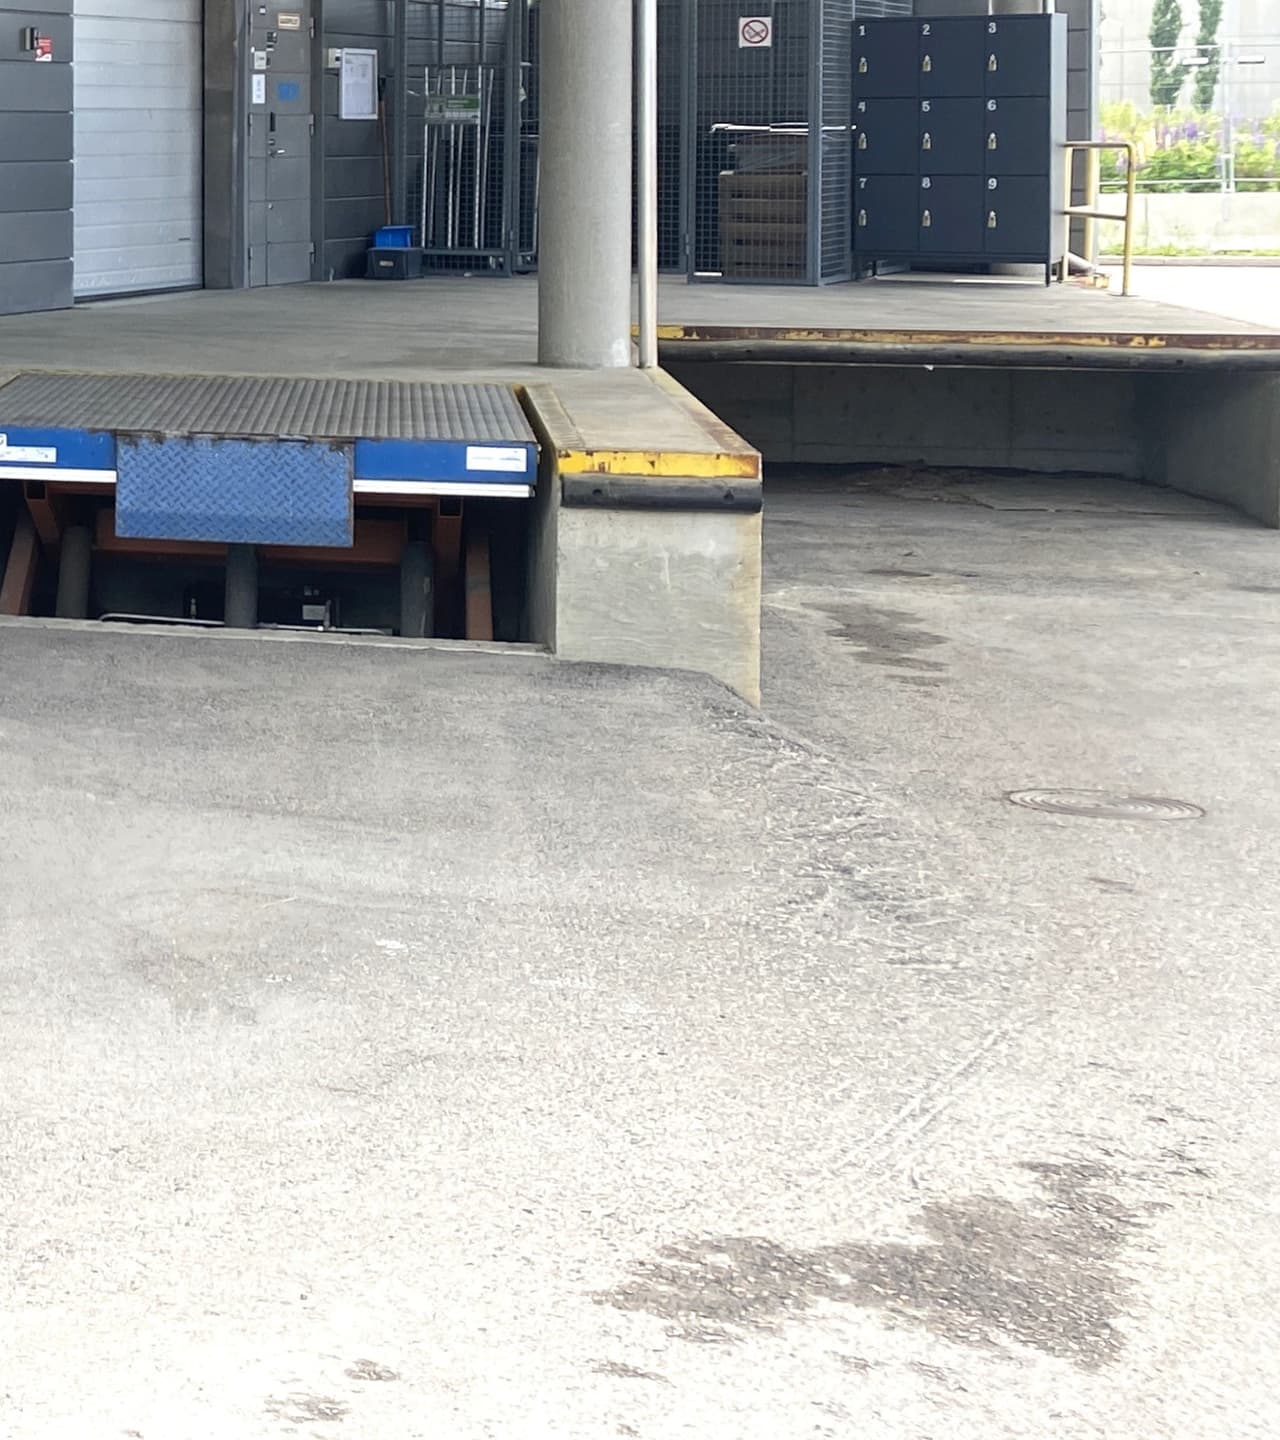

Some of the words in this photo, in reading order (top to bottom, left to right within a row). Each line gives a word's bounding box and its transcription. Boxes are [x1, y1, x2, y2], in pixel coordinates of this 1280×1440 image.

[859, 25, 866, 36] 1
[922, 24, 931, 35] 2
[988, 22, 997, 34] 3
[858, 101, 866, 112] 4
[922, 101, 931, 112] 5
[987, 99, 997, 111] 6
[859, 178, 867, 188] 7
[922, 177, 931, 188] 8
[988, 178, 997, 189] 9
